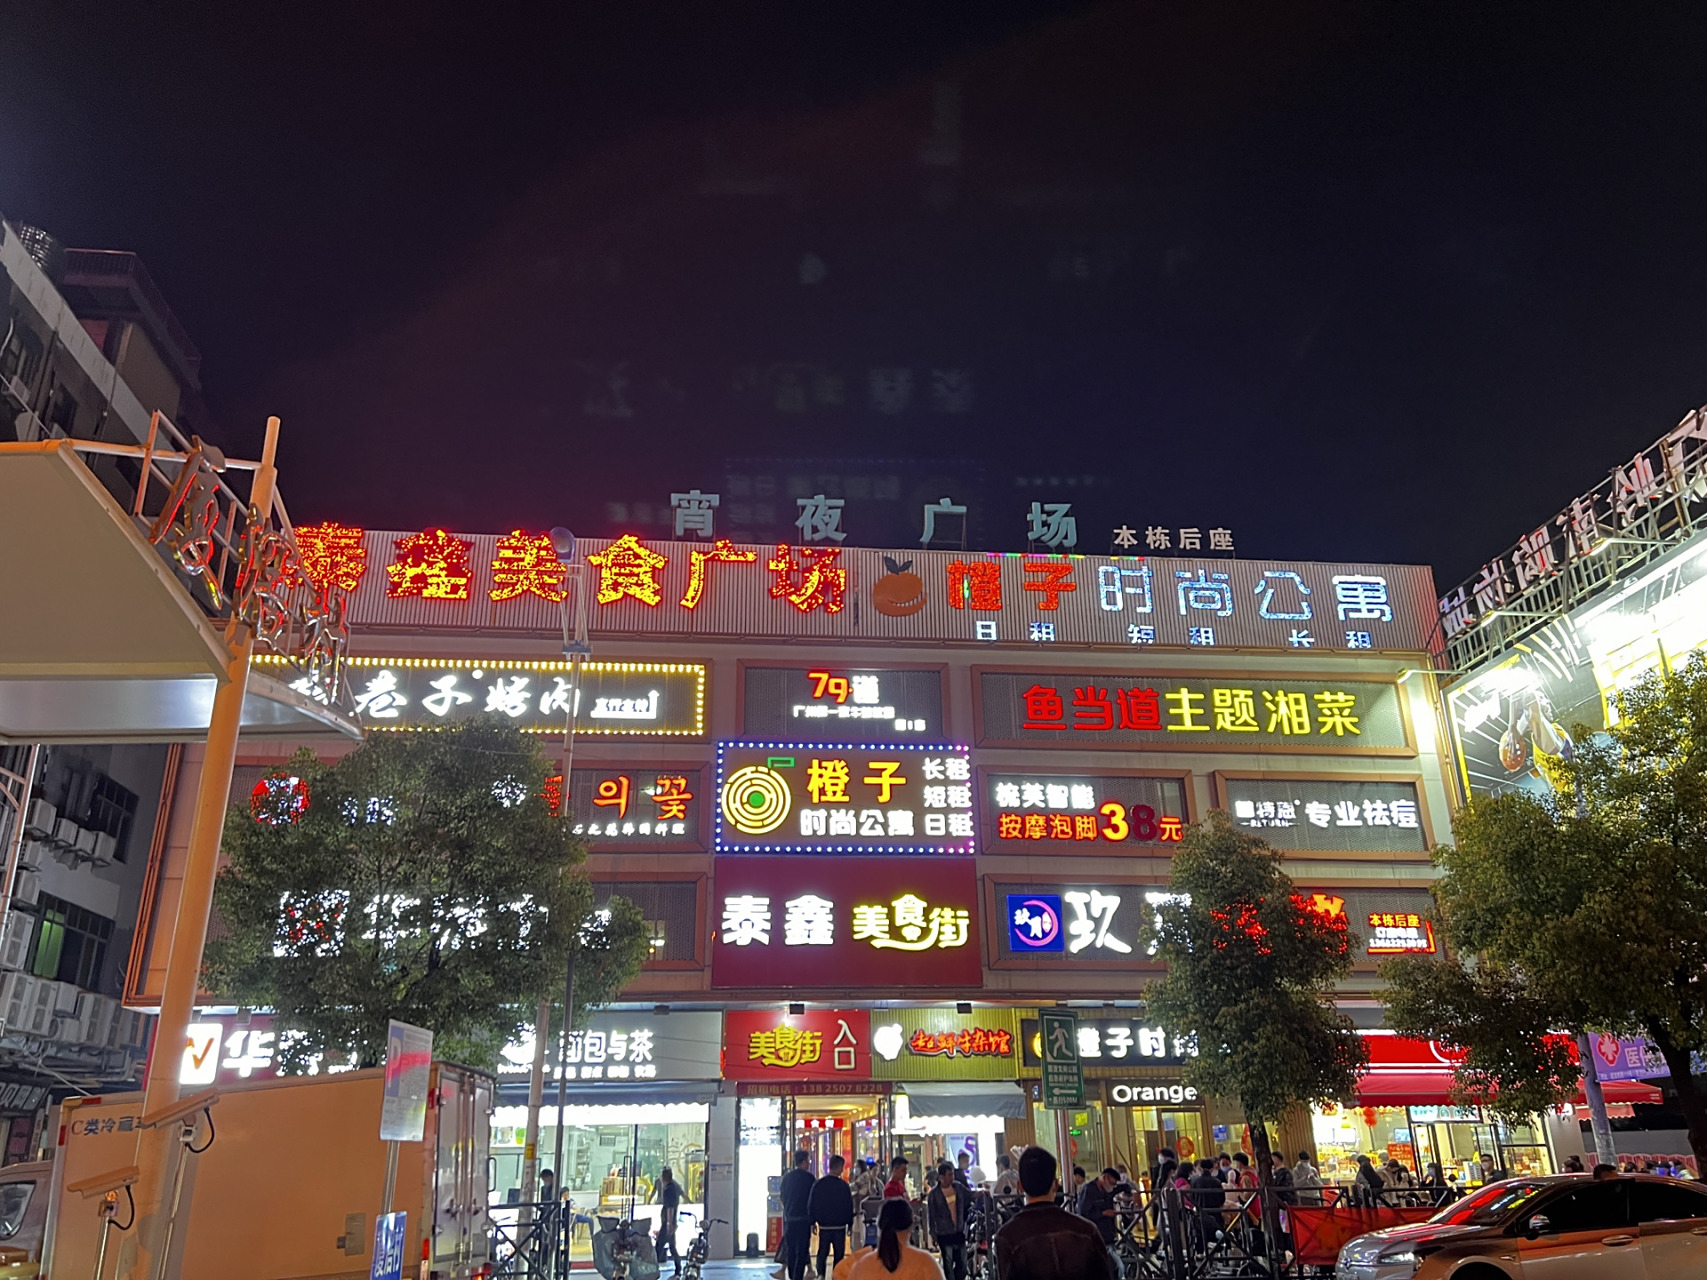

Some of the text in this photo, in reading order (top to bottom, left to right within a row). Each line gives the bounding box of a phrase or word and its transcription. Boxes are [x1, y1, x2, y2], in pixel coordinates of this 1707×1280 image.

[670, 489, 1078, 548] 宵夜广场
[1113, 525, 1236, 552] 本栋后座
[947, 560, 1393, 622] 橙子时尚公寓
[1022, 684, 1362, 736] 鱼当道主题湘菜
[807, 758, 907, 804] 橙子
[922, 757, 972, 780] 长租
[923, 785, 972, 808] 短租
[800, 808, 915, 837] 时尚公寓
[924, 813, 975, 837] 日租
[1304, 799, 1420, 829] 专业祛痘
[721, 894, 835, 946] 泰鑫
[852, 892, 970, 951] 美食街
[1368, 912, 1421, 928] 本栋后座
[748, 1023, 823, 1068] 美食街
[834, 1019, 858, 1071] 入口
[909, 1027, 1014, 1057] 超鲜牛杂馆
[825, 1083, 852, 1093] 2507
[1112, 1084, 1198, 1104] Orange
